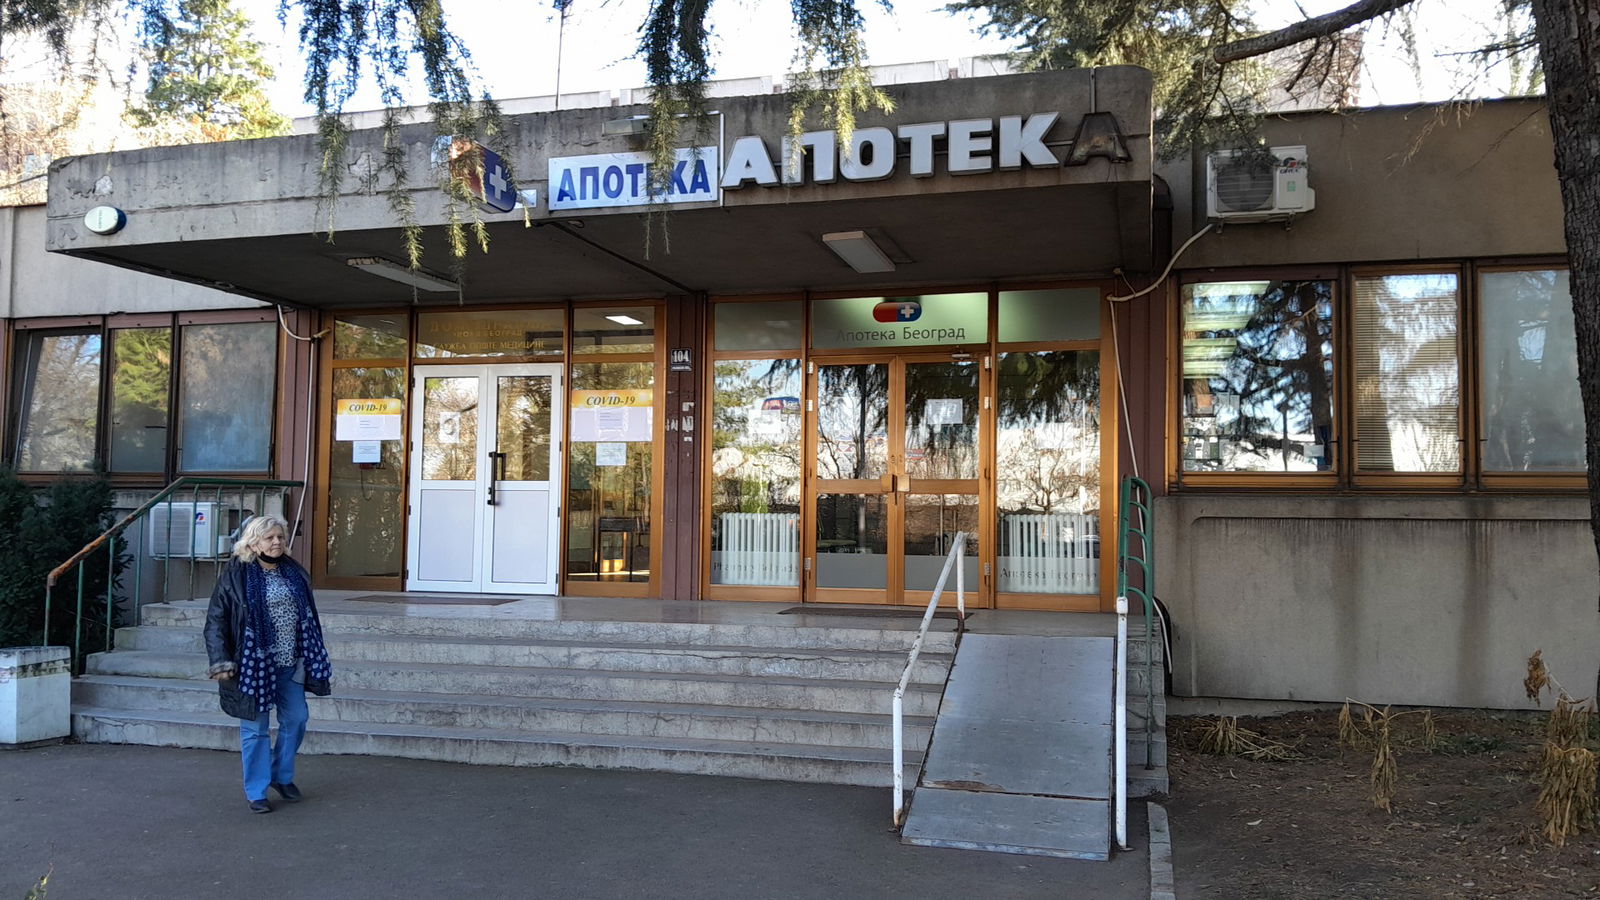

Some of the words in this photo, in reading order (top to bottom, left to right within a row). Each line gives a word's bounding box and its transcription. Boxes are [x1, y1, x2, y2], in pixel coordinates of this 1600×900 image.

[719, 111, 1133, 190] АПОТЕКА
[557, 159, 711, 202] АПОТЕКА
[836, 329, 896, 342] Апотека
[903, 326, 965, 341] Београд
[673, 349, 690, 362] 104
[349, 403, 388, 412] COVID-19
[586, 396, 636, 406] COVID-19
